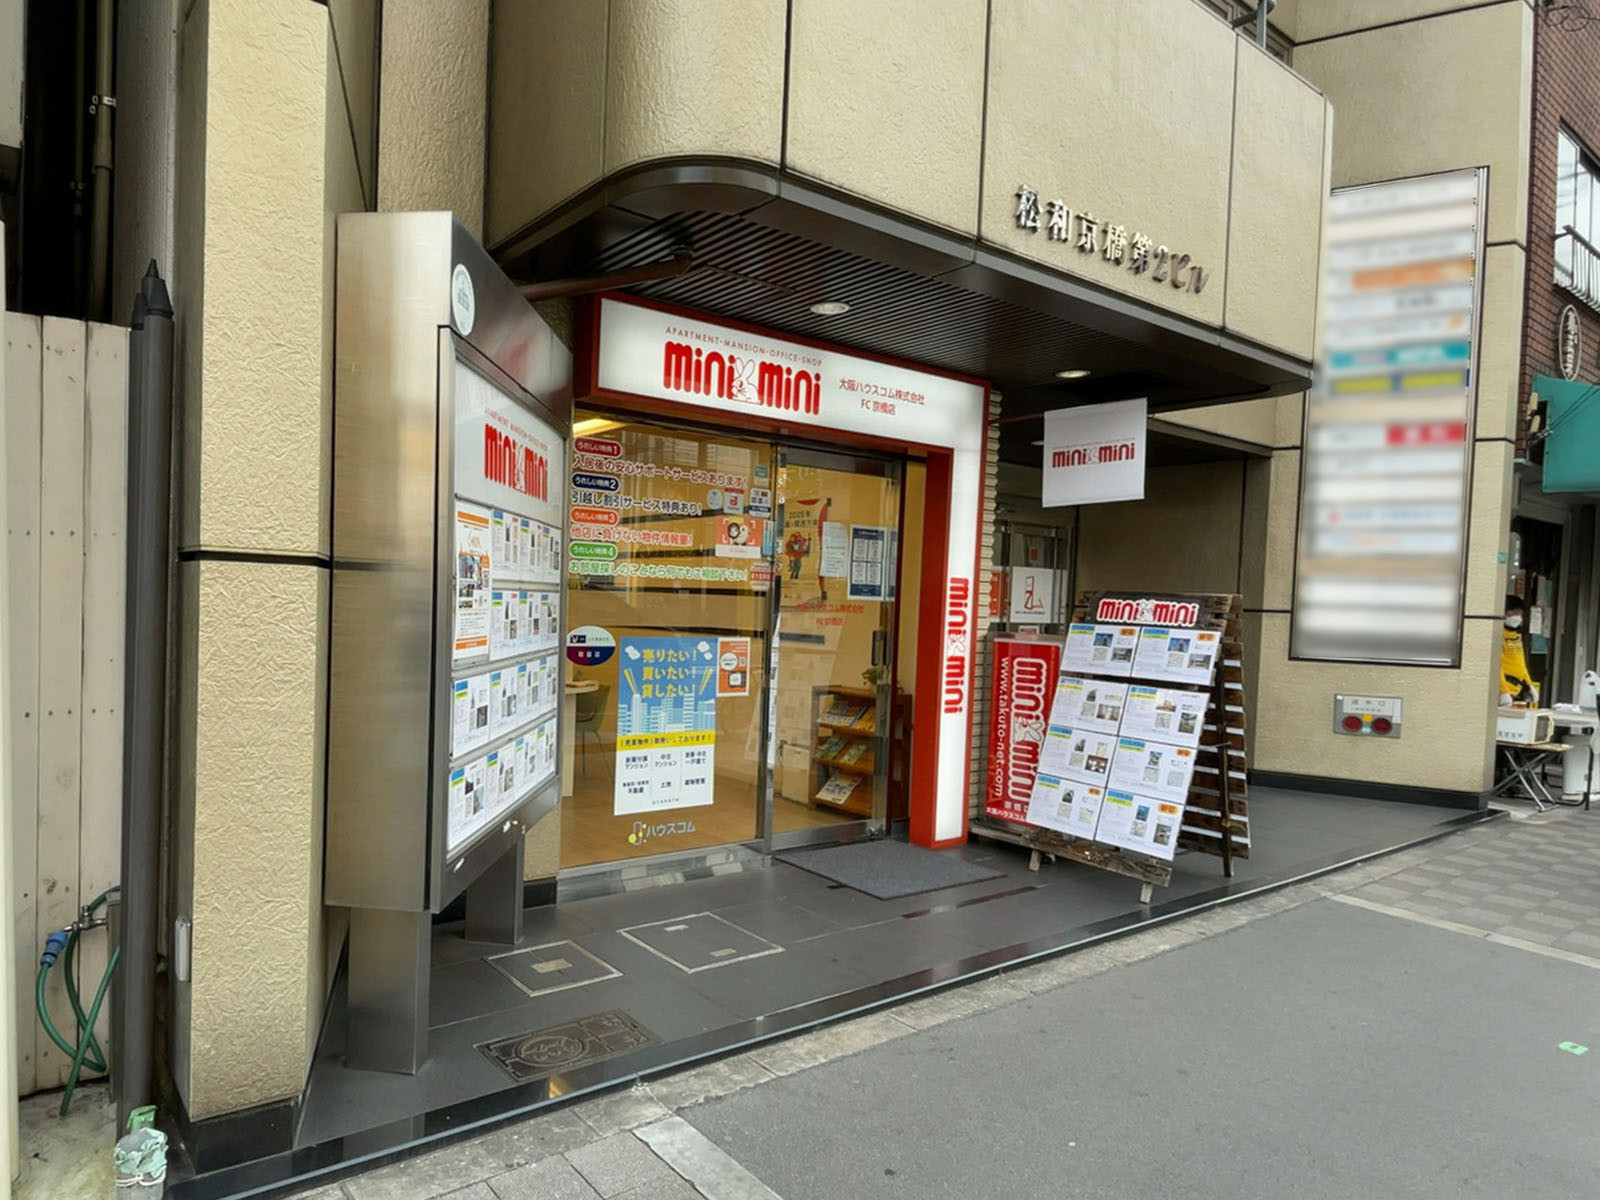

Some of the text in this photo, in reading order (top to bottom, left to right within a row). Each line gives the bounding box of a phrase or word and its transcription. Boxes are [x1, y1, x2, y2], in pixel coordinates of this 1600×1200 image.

[664, 341, 821, 415] mini mini
[839, 379, 925, 405] 大阪ハウスコム株式会社
[485, 423, 516, 489] mini
[525, 447, 548, 502] mini
[1052, 448, 1087, 468] mini
[1099, 443, 1135, 463] mini
[1097, 599, 1199, 627] mini mini
[642, 649, 697, 663] 売りたい!
[943, 577, 969, 714] mini mini
[642, 667, 697, 680] 買いたい!
[1011, 657, 1047, 721] mini
[995, 656, 1009, 798] www.takuto-net.com
[646, 821, 696, 837] ハウスコム
